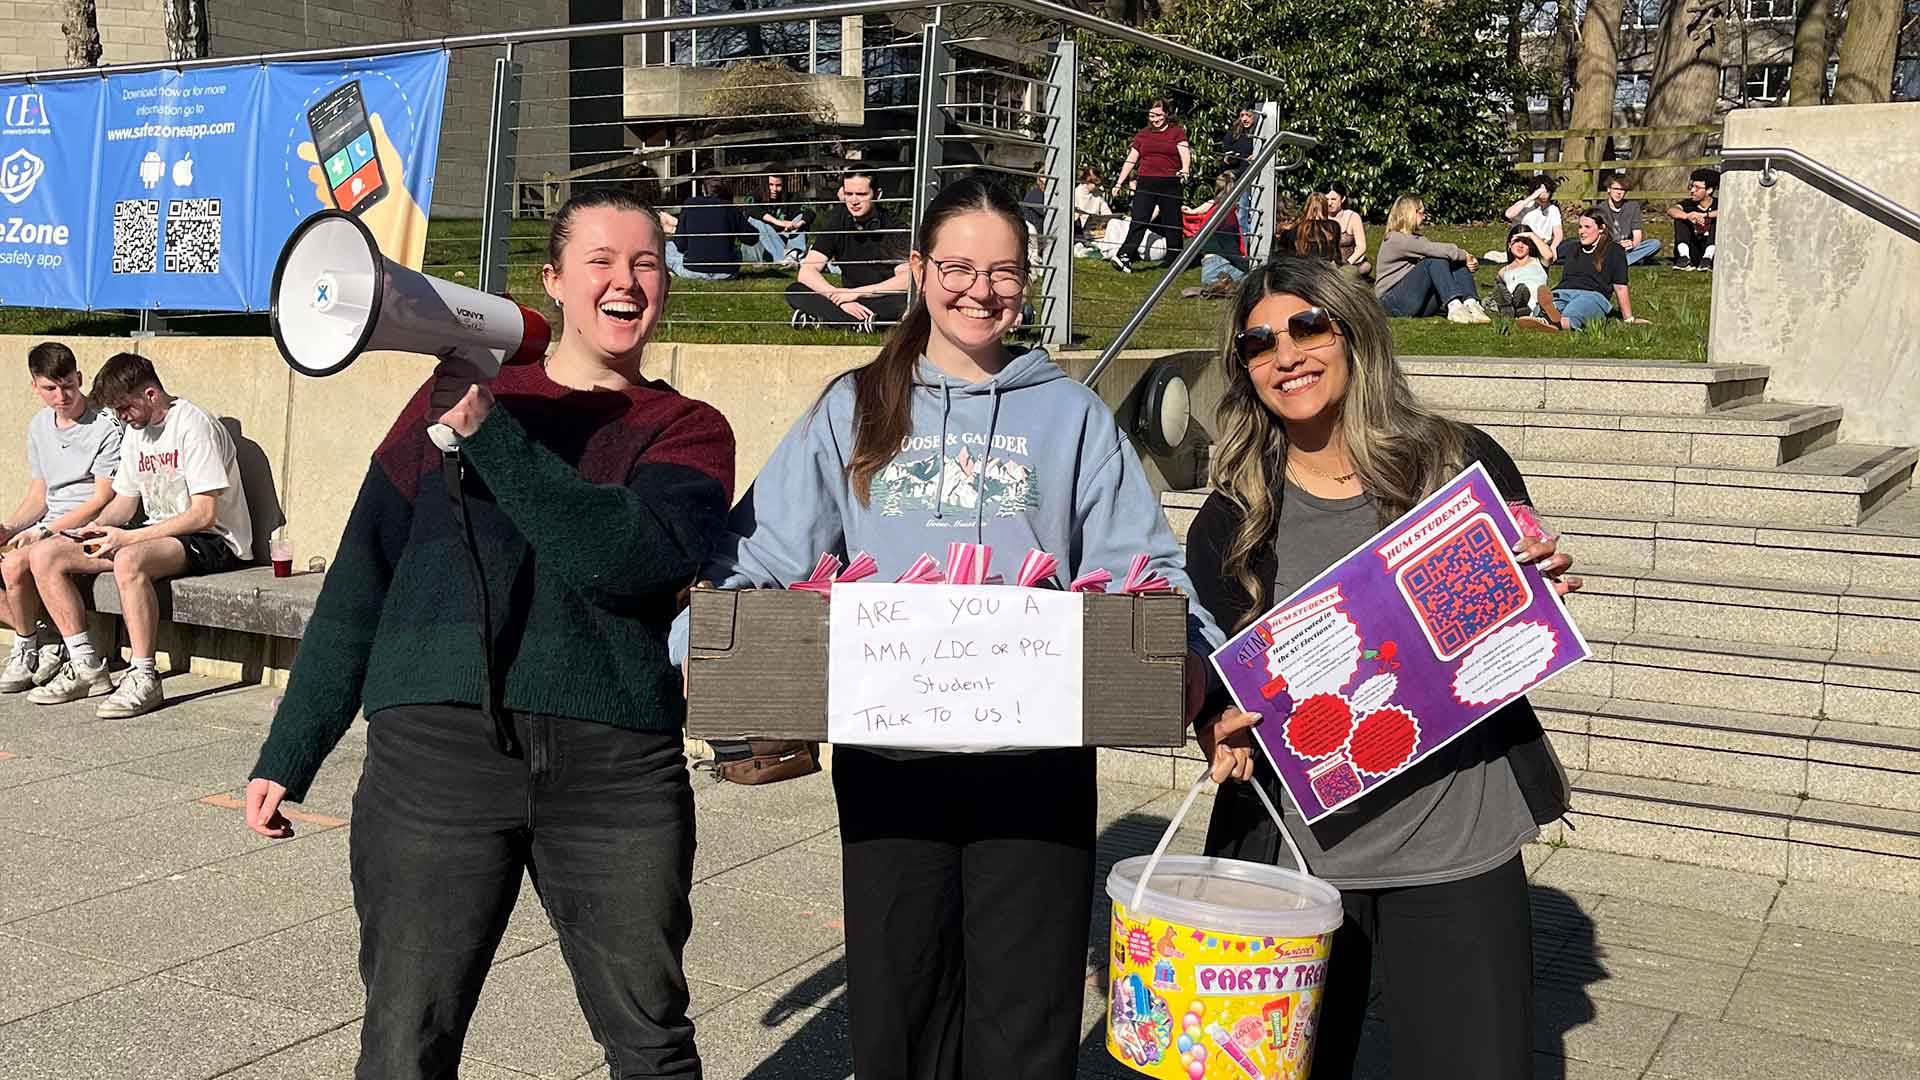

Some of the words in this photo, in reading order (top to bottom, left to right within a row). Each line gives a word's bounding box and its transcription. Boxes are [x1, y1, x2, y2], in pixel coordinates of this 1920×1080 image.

[160, 85, 181, 97] now
[183, 88, 191, 97] or
[192, 86, 204, 96] for
[204, 84, 226, 95] more
[6, 94, 49, 126] UEA
[184, 106, 194, 117] go
[196, 103, 205, 114] to
[107, 121, 235, 141] www.safezoneapp.com
[0, 250, 34, 268] safety
[37, 254, 63, 269] app
[456, 307, 485, 321] VONYX
[900, 435, 941, 452] OOSE
[945, 432, 958, 446] &
[961, 432, 1028, 456] GADER
[1386, 536, 1413, 560] HUM
[1414, 494, 1472, 541] STUDENTS!
[857, 600, 910, 628] ARE
[949, 597, 1000, 624] YOU
[1024, 594, 1040, 615] A
[1272, 610, 1292, 627] HUM
[1291, 591, 1338, 620] STUDENTS!
[1272, 639, 1291, 655] Have
[1290, 631, 1304, 646] you
[1304, 616, 1326, 633] voted
[1323, 611, 1332, 620] in
[1278, 652, 1289, 663] the
[1300, 619, 1336, 648] Elections?
[934, 639, 978, 659] LDC
[1019, 638, 1063, 657] PPL
[1239, 630, 1267, 664] ATTN
[912, 674, 996, 695] Student
[853, 705, 913, 732] TALK
[924, 706, 952, 723] TO
[1200, 965, 1289, 990] PARTY
